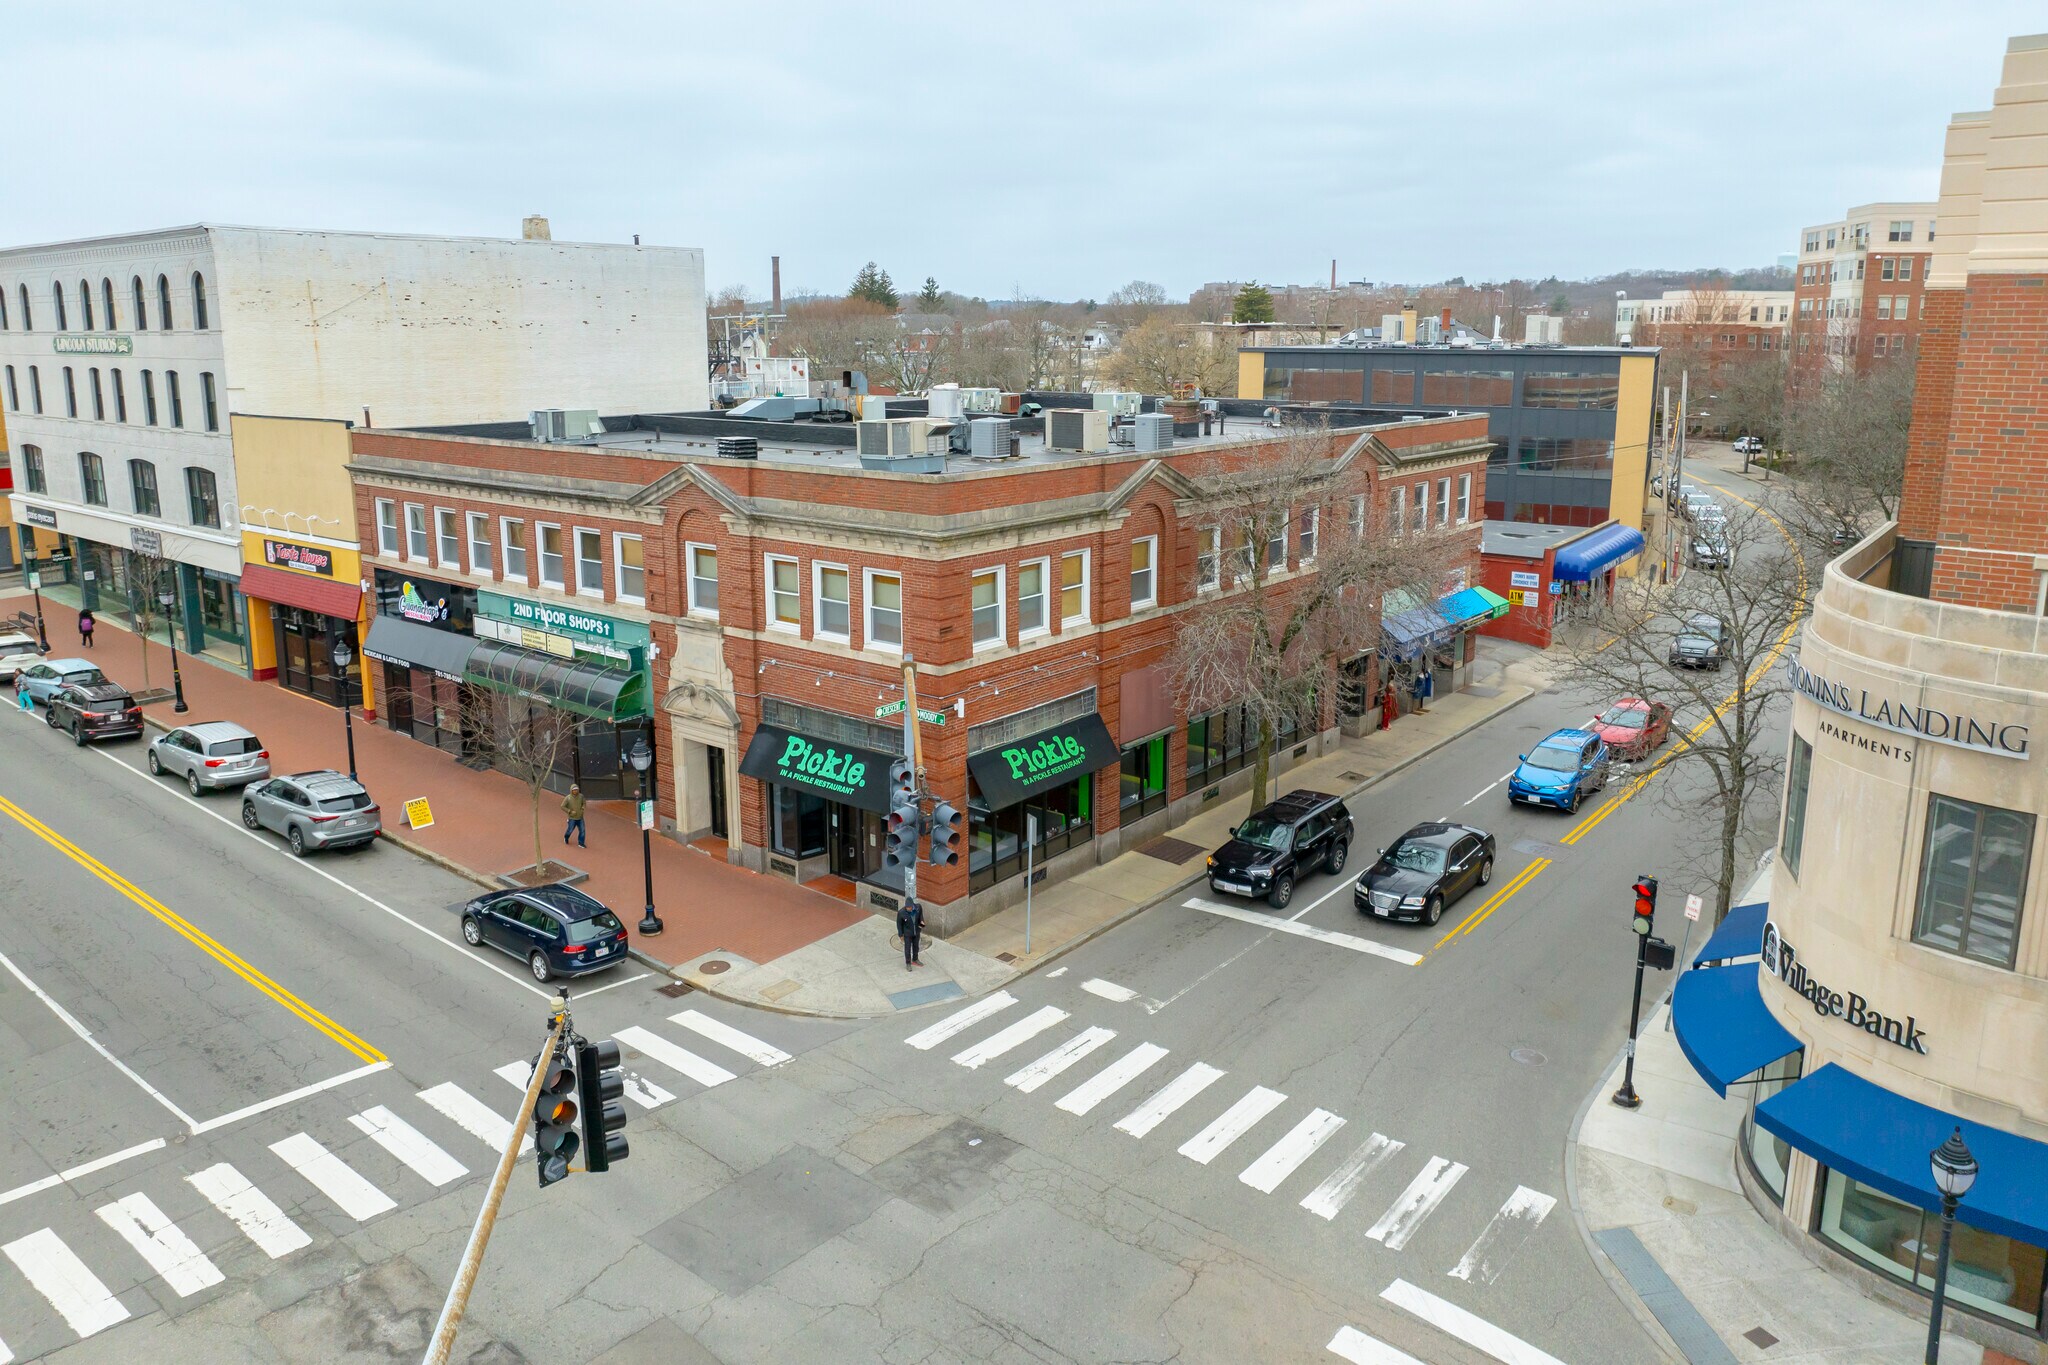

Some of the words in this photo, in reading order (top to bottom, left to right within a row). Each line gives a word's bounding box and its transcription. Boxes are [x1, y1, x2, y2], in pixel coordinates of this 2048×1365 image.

[56, 338, 86, 353] LINCOLN
[86, 338, 117, 353] STUDIOS
[275, 544, 299, 561] Taste
[299, 548, 328, 567] House
[1510, 591, 1523, 600] ATM
[513, 603, 532, 618] 2ND
[534, 607, 567, 626] FLOOR
[569, 613, 604, 635] SHOPS
[363, 649, 382, 660] MEXICAN
[386, 655, 398, 664] LATIN
[398, 659, 410, 668] FOOD
[882, 702, 901, 715] CRESCENT
[1787, 653, 1850, 711] CRONIN'S
[1859, 688, 2029, 753] LANDING
[919, 711, 937, 721] MOODY
[1819, 720, 1912, 763] APARTMENTS
[792, 772, 814, 785] PICKLE
[813, 778, 855, 795] RESTAURANT
[1033, 770, 1052, 781] PICKLE
[408, 799, 427, 807] JESUS
[1779, 948, 1844, 1016] Village
[1844, 991, 1926, 1055] Bank
